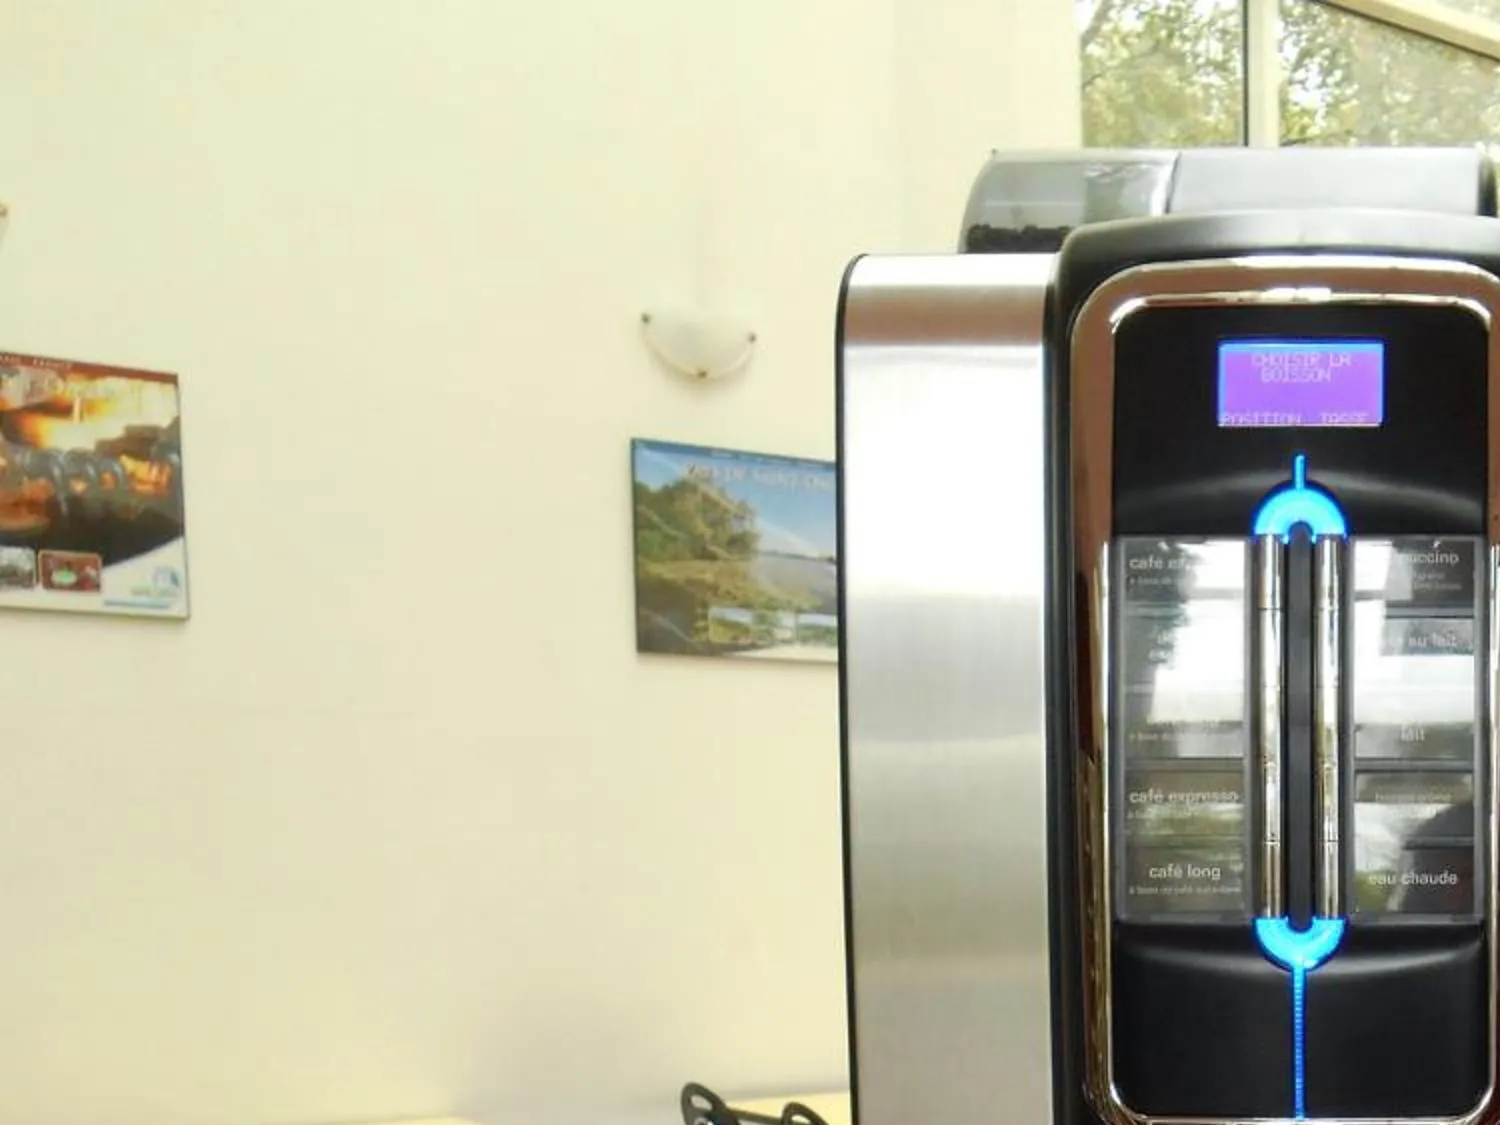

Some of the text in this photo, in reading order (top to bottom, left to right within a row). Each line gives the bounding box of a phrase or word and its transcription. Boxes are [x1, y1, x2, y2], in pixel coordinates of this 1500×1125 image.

[1149, 863, 1221, 881] café long
[1401, 869, 1458, 886] chaude
